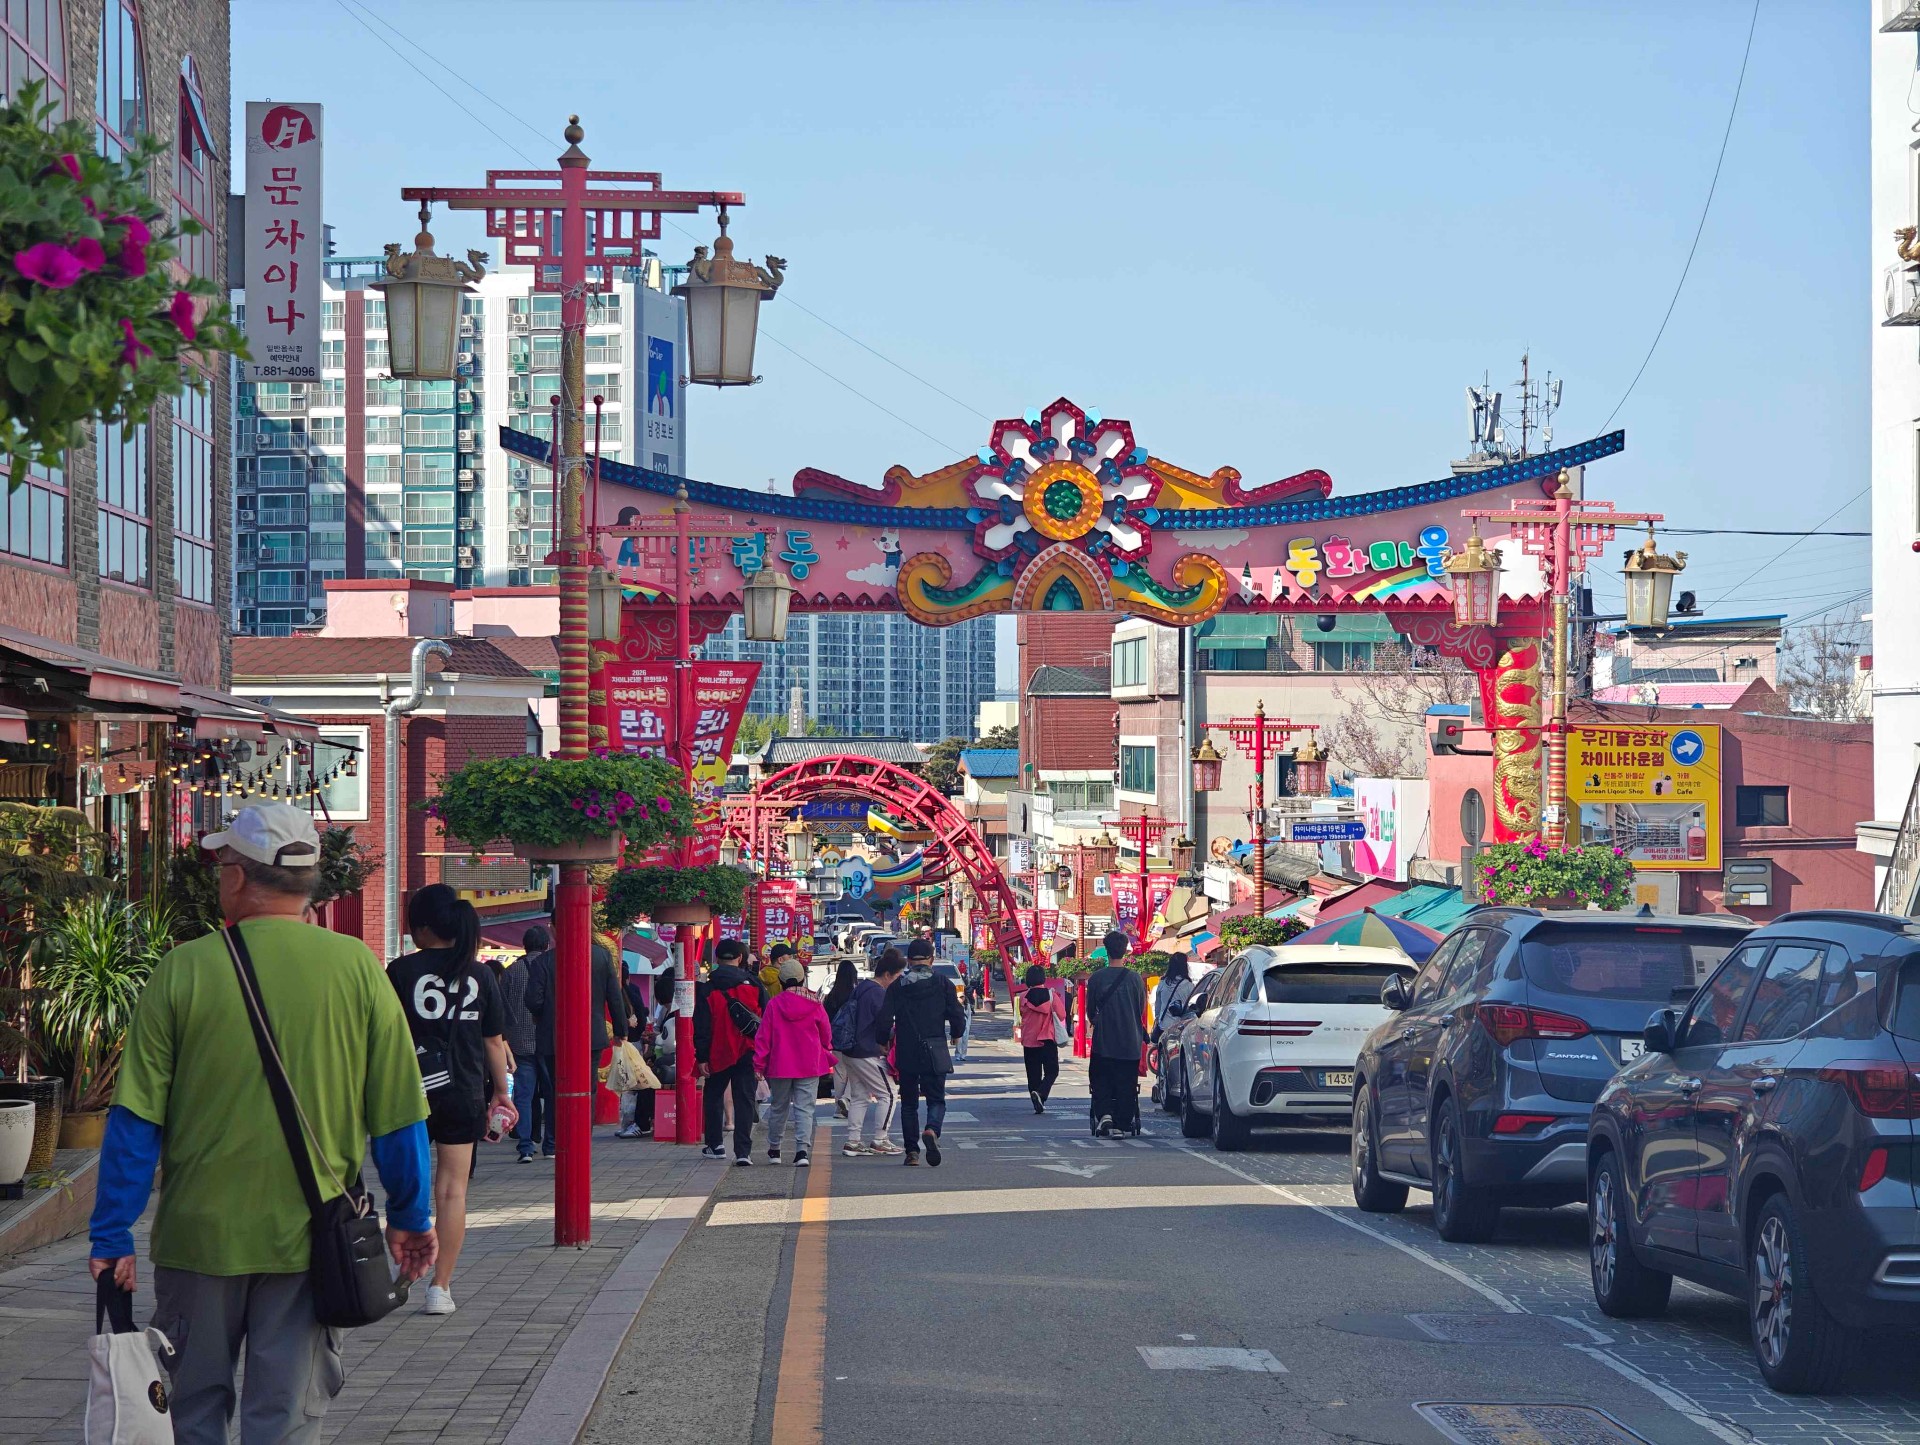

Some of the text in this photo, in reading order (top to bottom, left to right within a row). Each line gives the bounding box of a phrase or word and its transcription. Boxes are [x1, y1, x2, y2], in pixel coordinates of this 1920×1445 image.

[263, 167, 307, 336] 문차이나
[266, 345, 304, 353] 일반음식점
[269, 354, 300, 363] 예약안내
[253, 366, 316, 377] T.881-4096
[1286, 524, 1454, 588] 동화마을
[620, 709, 665, 741] 문화
[1580, 751, 1665, 767] 차이나타운점
[765, 908, 791, 924] 문화
[414, 974, 479, 1021] 62
